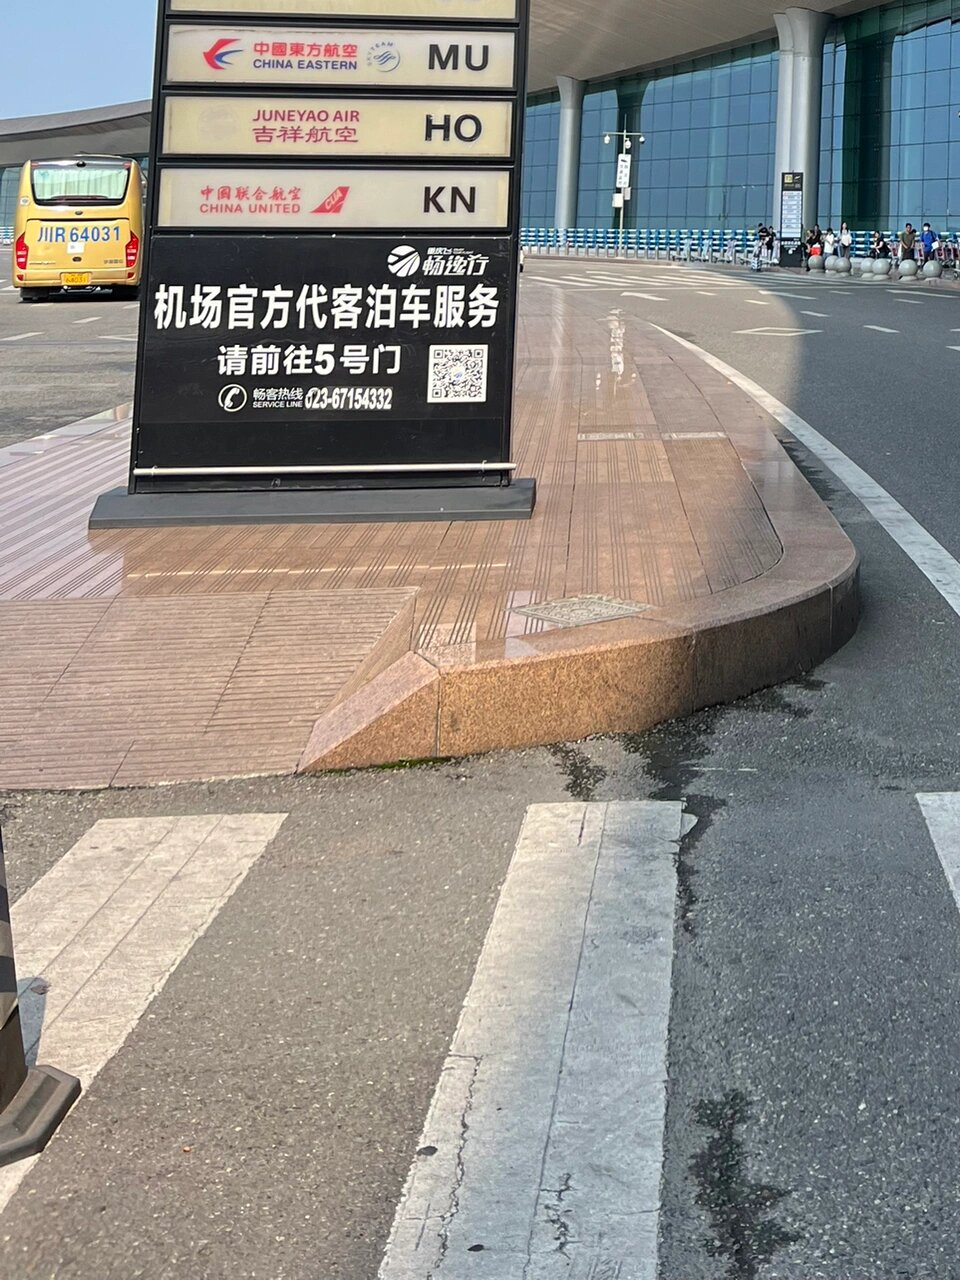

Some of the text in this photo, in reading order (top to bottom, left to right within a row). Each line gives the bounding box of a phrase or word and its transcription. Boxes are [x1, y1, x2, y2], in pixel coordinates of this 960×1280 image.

[253, 41, 358, 59] 中國東方航空
[428, 43, 489, 71] MU
[252, 58, 358, 71] CHINA EASTERN
[252, 109, 360, 123] JUNEYAO AIR
[252, 125, 359, 144] 吉祥航空
[425, 113, 482, 143] HO
[200, 185, 302, 201] 中国联合航空
[422, 186, 477, 214] KN
[199, 203, 301, 214] CHINA UNITED
[153, 283, 500, 330] 机场官方代客泊车服务
[217, 343, 402, 376] 请前往5号门
[252, 401, 285, 409] SERVICE
[304, 387, 393, 410] 023-67154332
